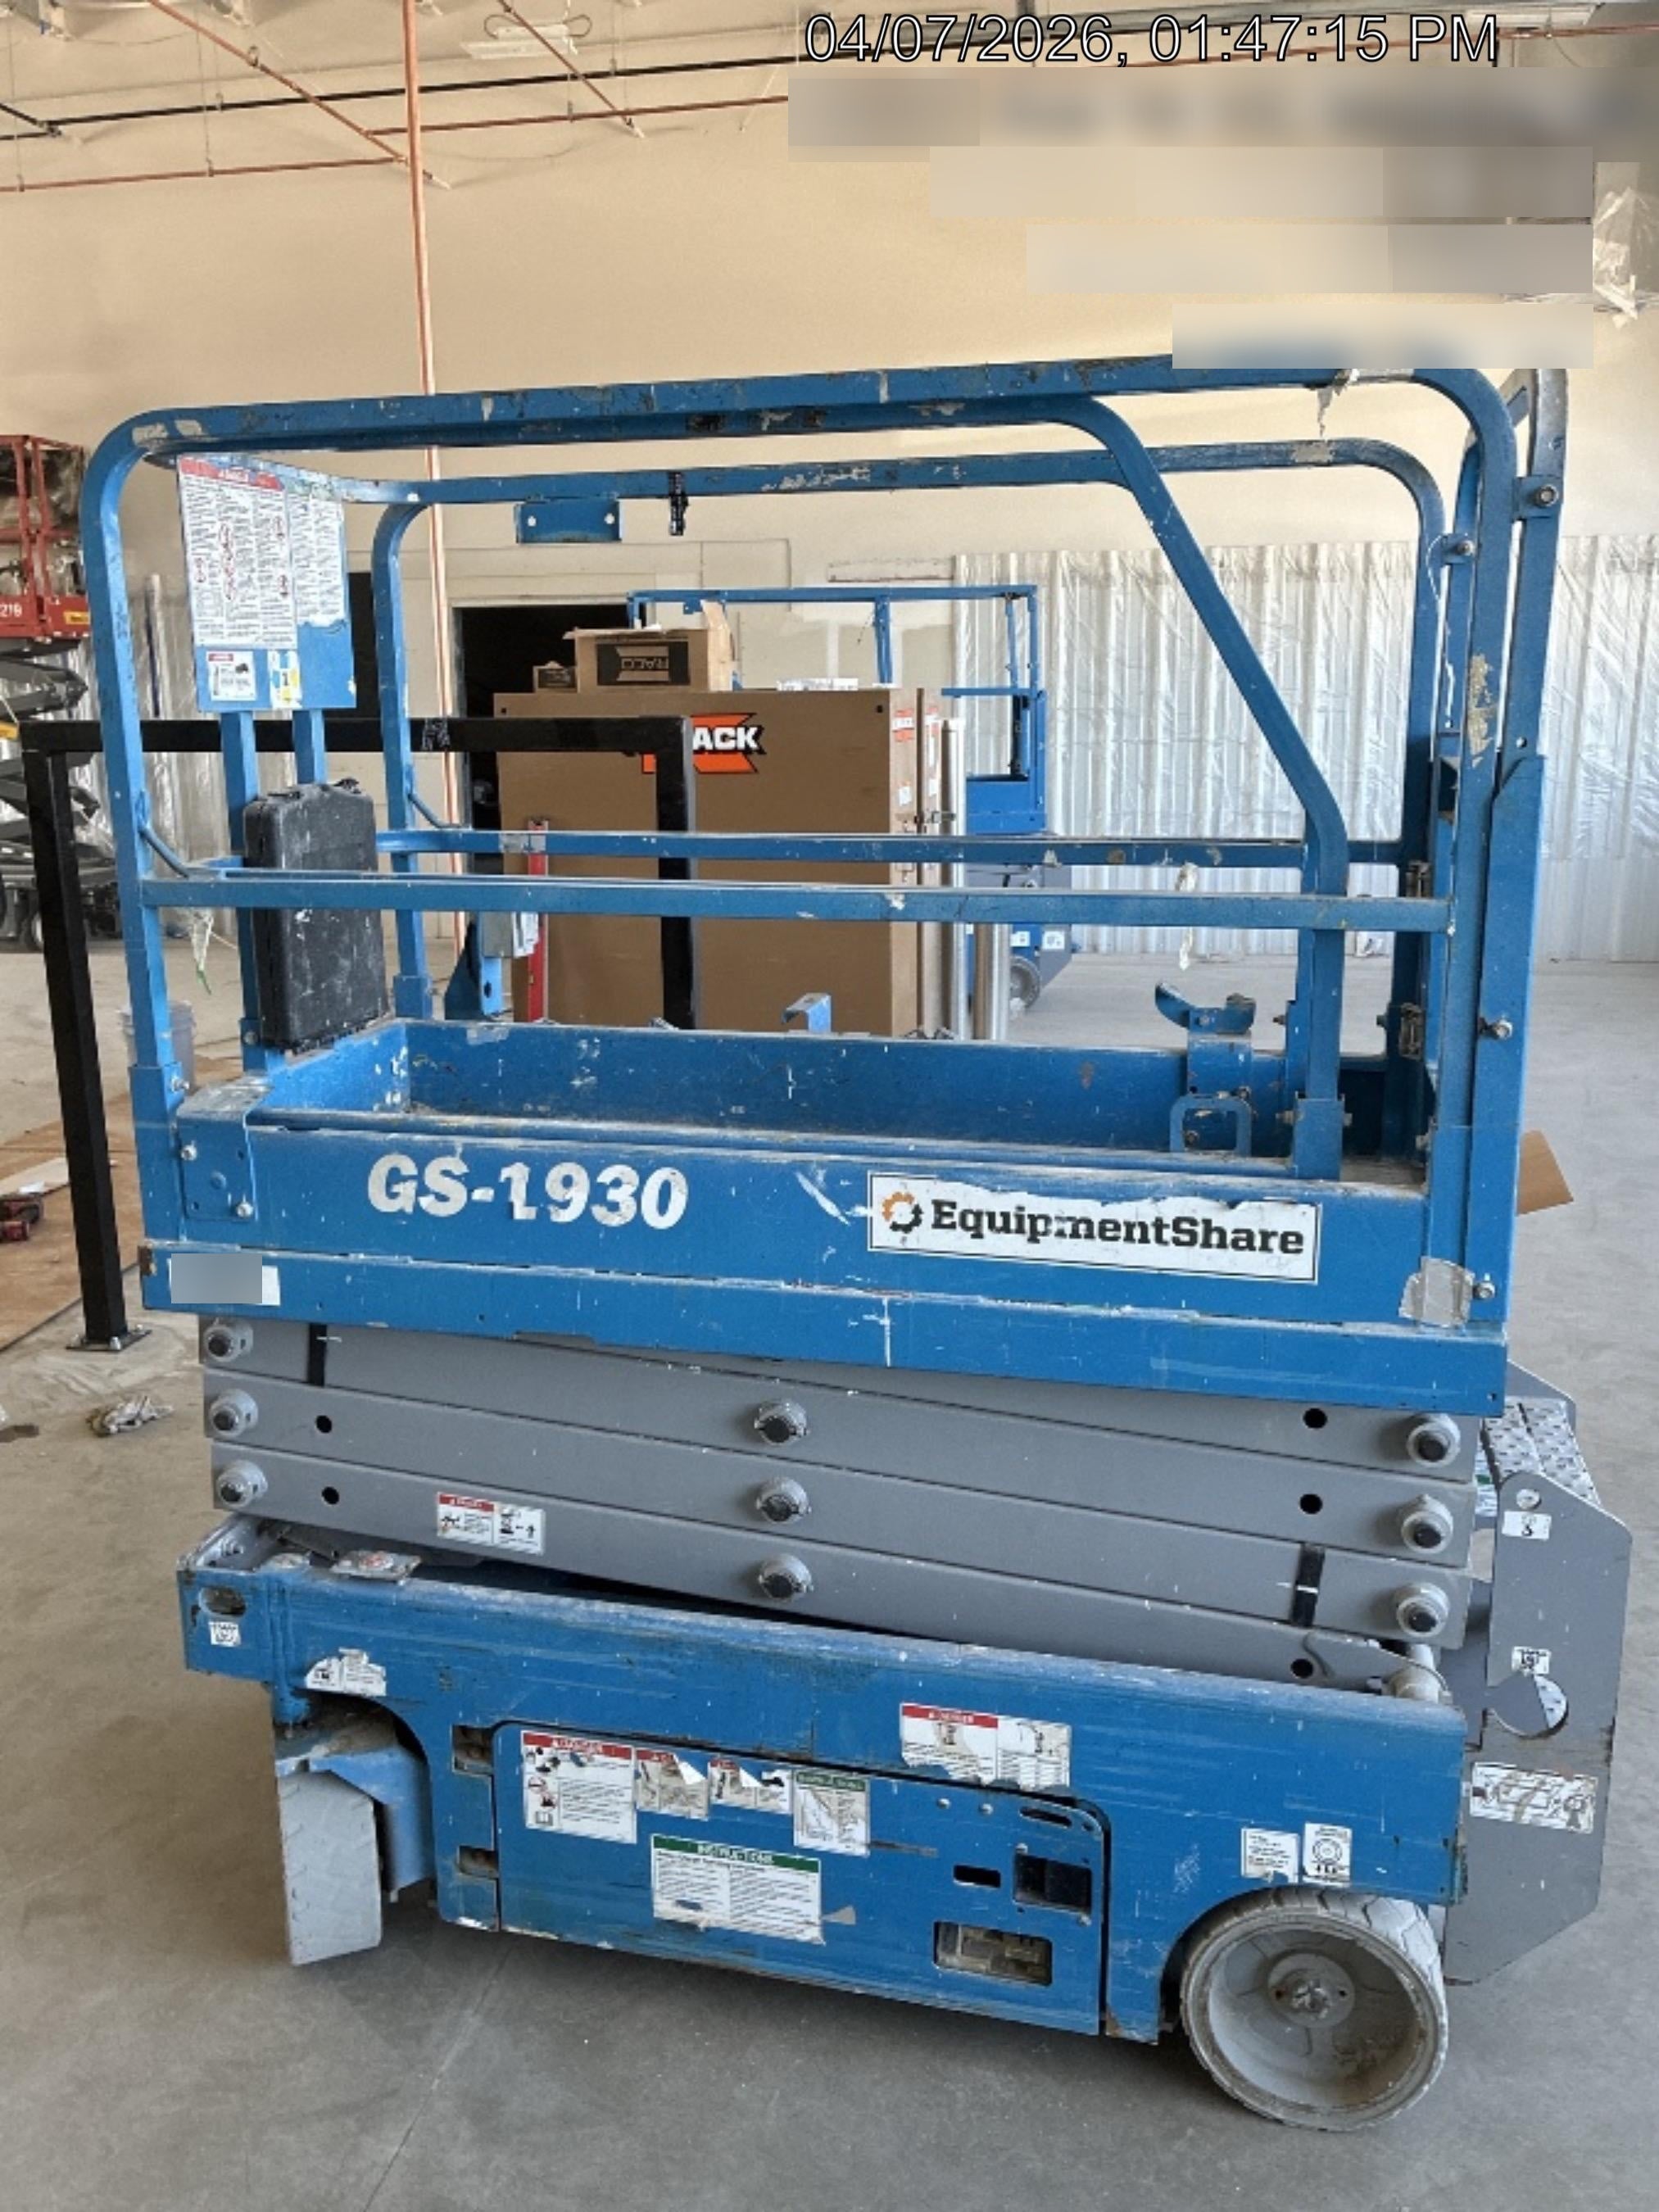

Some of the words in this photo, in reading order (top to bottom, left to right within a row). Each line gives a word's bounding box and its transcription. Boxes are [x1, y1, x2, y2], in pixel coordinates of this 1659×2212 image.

[692, 726, 759, 750] ACK
[367, 1154, 689, 1231] GS-1930
[931, 1199, 1304, 1254] EquipmentShare
